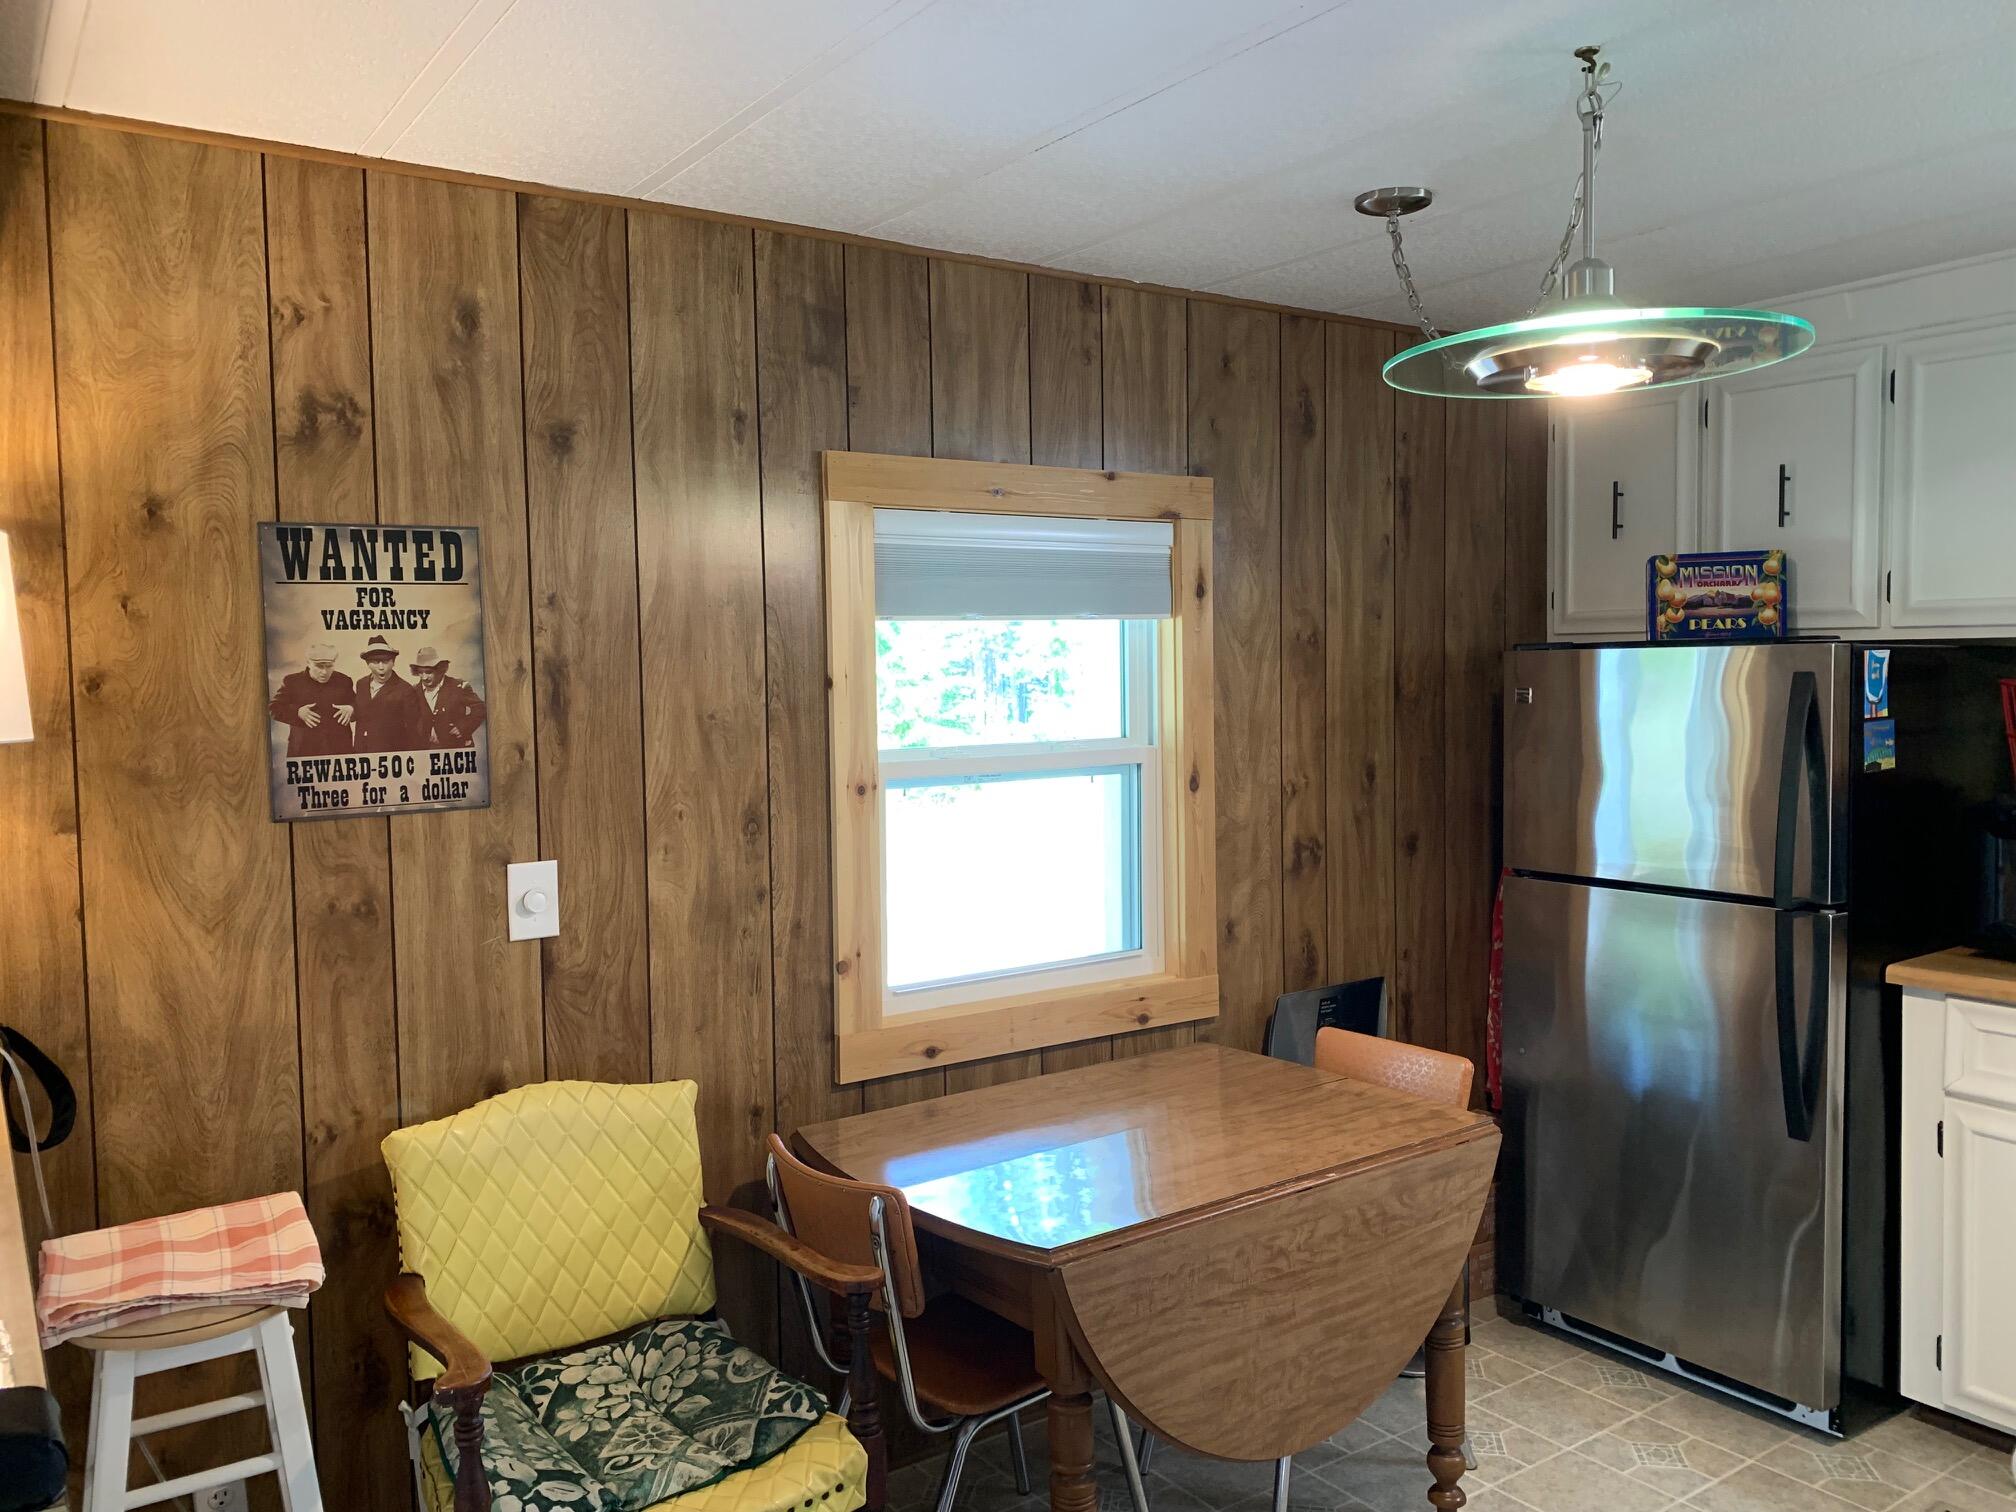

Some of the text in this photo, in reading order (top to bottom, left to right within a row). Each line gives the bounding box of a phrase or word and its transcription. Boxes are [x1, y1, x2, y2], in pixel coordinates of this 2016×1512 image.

[276, 527, 464, 581] WANTED
[1680, 564, 1758, 587] MISSION
[356, 587, 396, 607] FOR
[321, 609, 431, 630] VAGRANCY
[1689, 617, 1747, 630] PEARS
[430, 751, 477, 776] EACH
[298, 777, 469, 810] Three for a dollar
